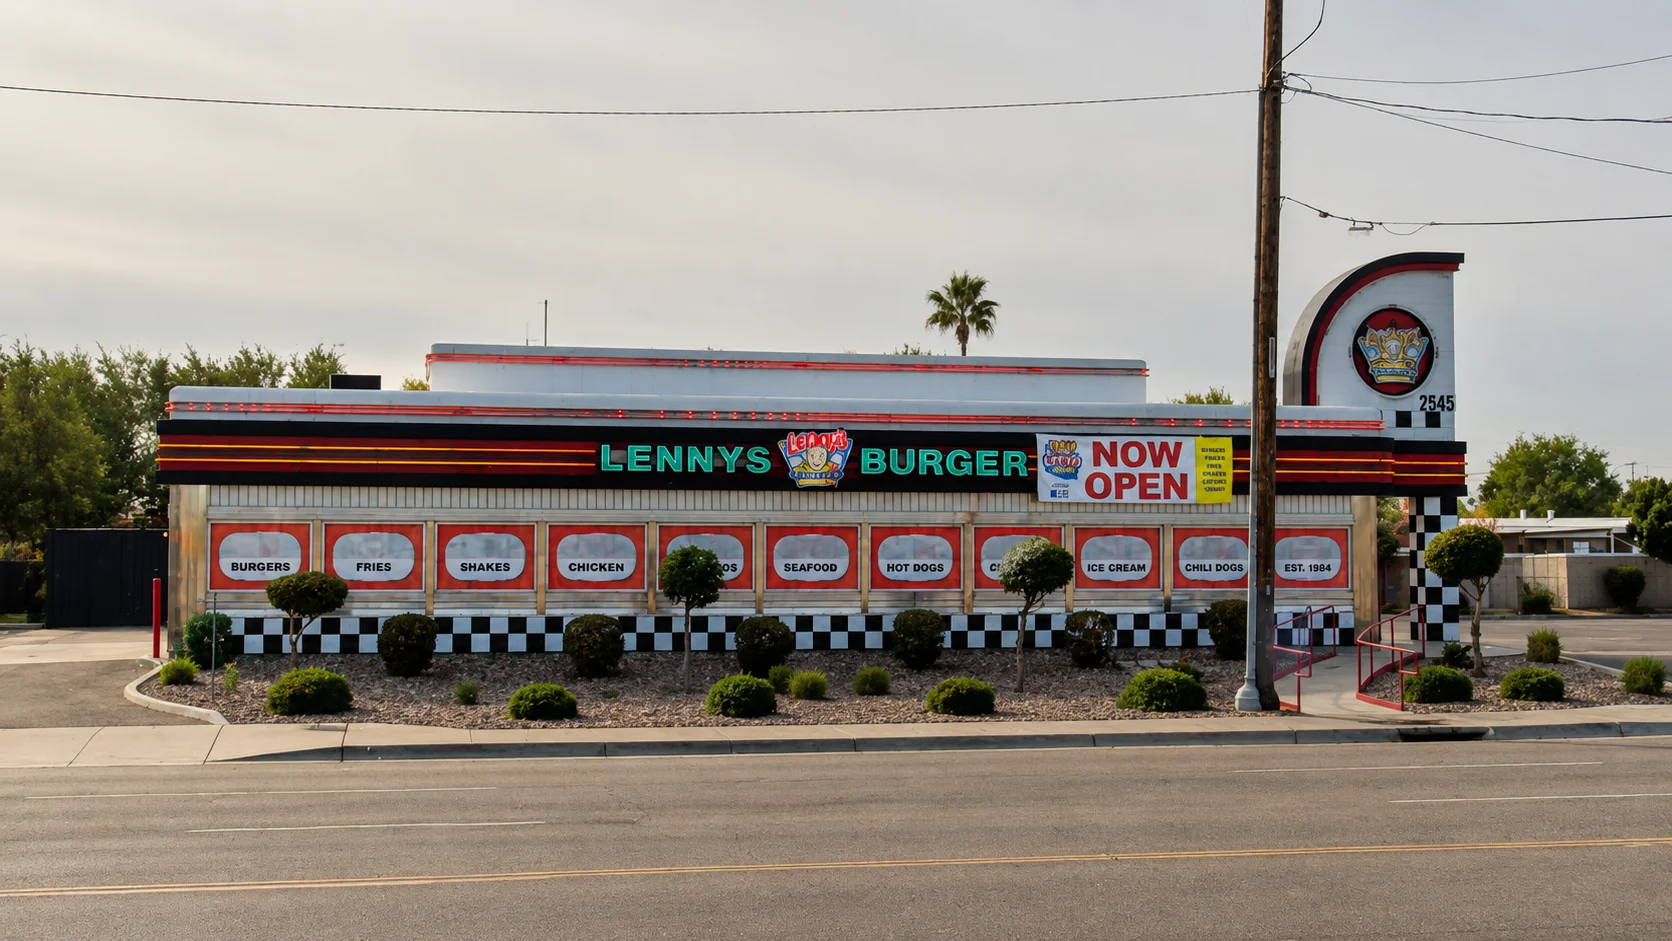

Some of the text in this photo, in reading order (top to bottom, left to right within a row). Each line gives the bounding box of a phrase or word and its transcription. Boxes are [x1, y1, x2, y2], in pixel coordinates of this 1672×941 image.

[1420, 395, 1455, 412] 2545
[1093, 441, 1183, 468] NOW
[600, 444, 1029, 477] LENNYS BURGER
[1085, 472, 1188, 500] OPEN
[230, 562, 291, 572] BURGERS
[355, 562, 392, 572] FRIES
[459, 562, 511, 572] SHAKES
[567, 562, 625, 572] CHICKEN
[783, 562, 838, 572] SEAFOOD
[886, 562, 945, 572] HOT DOGS
[1086, 563, 1147, 572] ICE CREAM
[1184, 563, 1244, 572] CHILI DOGS
[1284, 563, 1332, 572] EST. 1984
